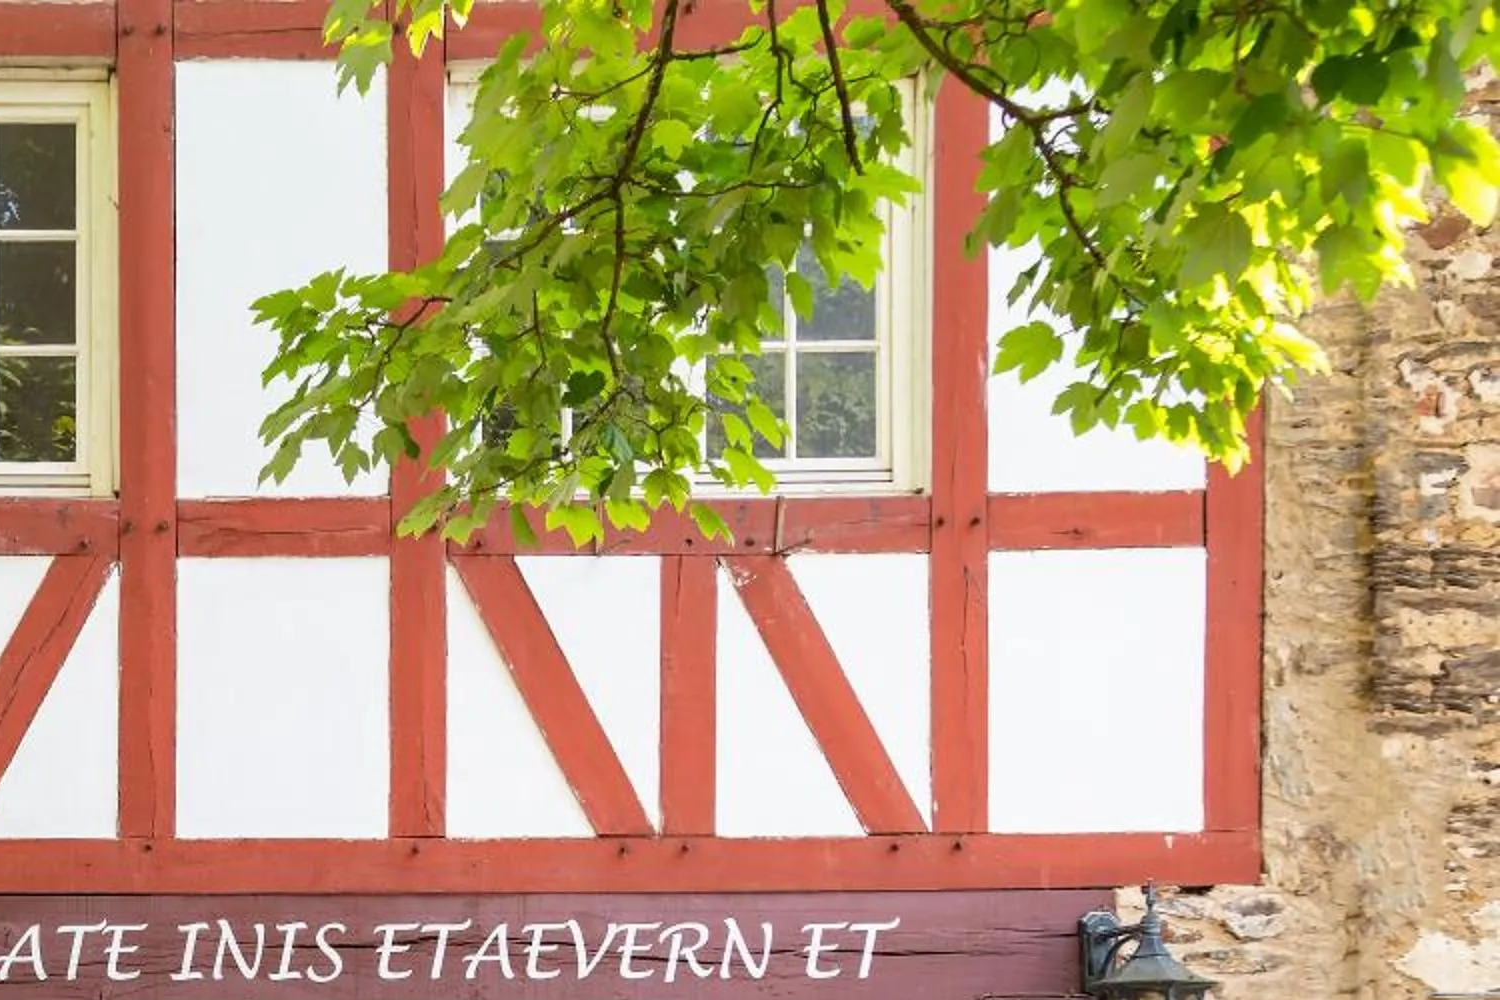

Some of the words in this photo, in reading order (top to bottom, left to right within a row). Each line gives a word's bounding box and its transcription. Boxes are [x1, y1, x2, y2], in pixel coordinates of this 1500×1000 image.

[169, 918, 345, 984] INIS
[373, 918, 774, 984] ETAEVERN
[801, 915, 901, 981] ET
